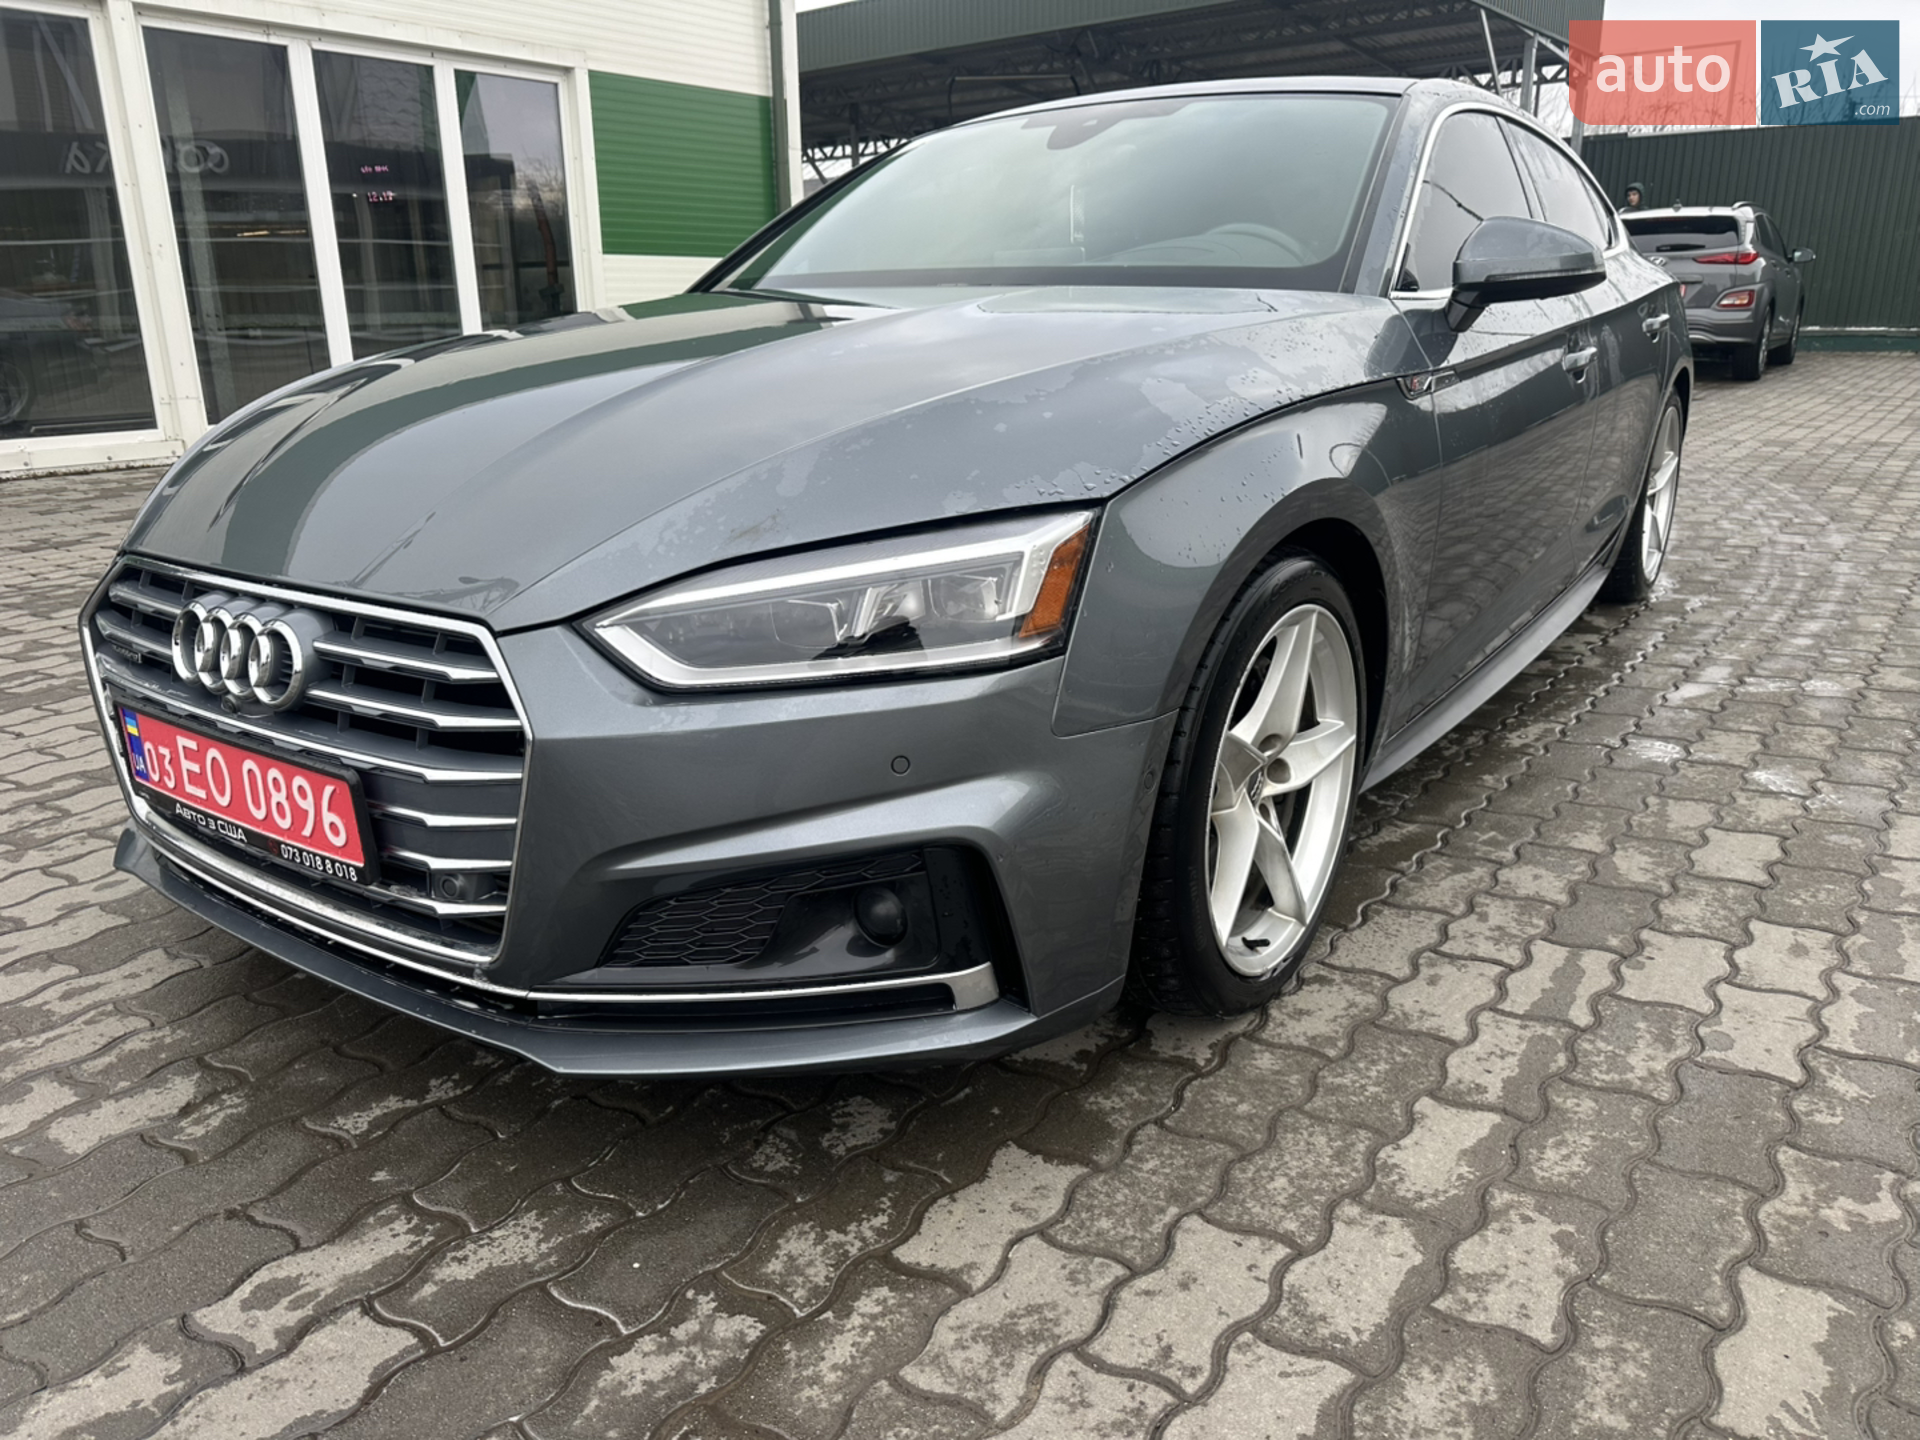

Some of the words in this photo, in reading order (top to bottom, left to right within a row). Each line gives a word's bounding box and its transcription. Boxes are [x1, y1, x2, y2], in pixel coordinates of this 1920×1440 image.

[132, 752, 147, 774] UA
[144, 740, 176, 790] 03
[242, 759, 347, 848] 0896
[216, 819, 248, 843] США
[280, 843, 301, 864] 073
[302, 851, 324, 871] 018
[324, 858, 334, 875] 8
[334, 862, 358, 883] 018
